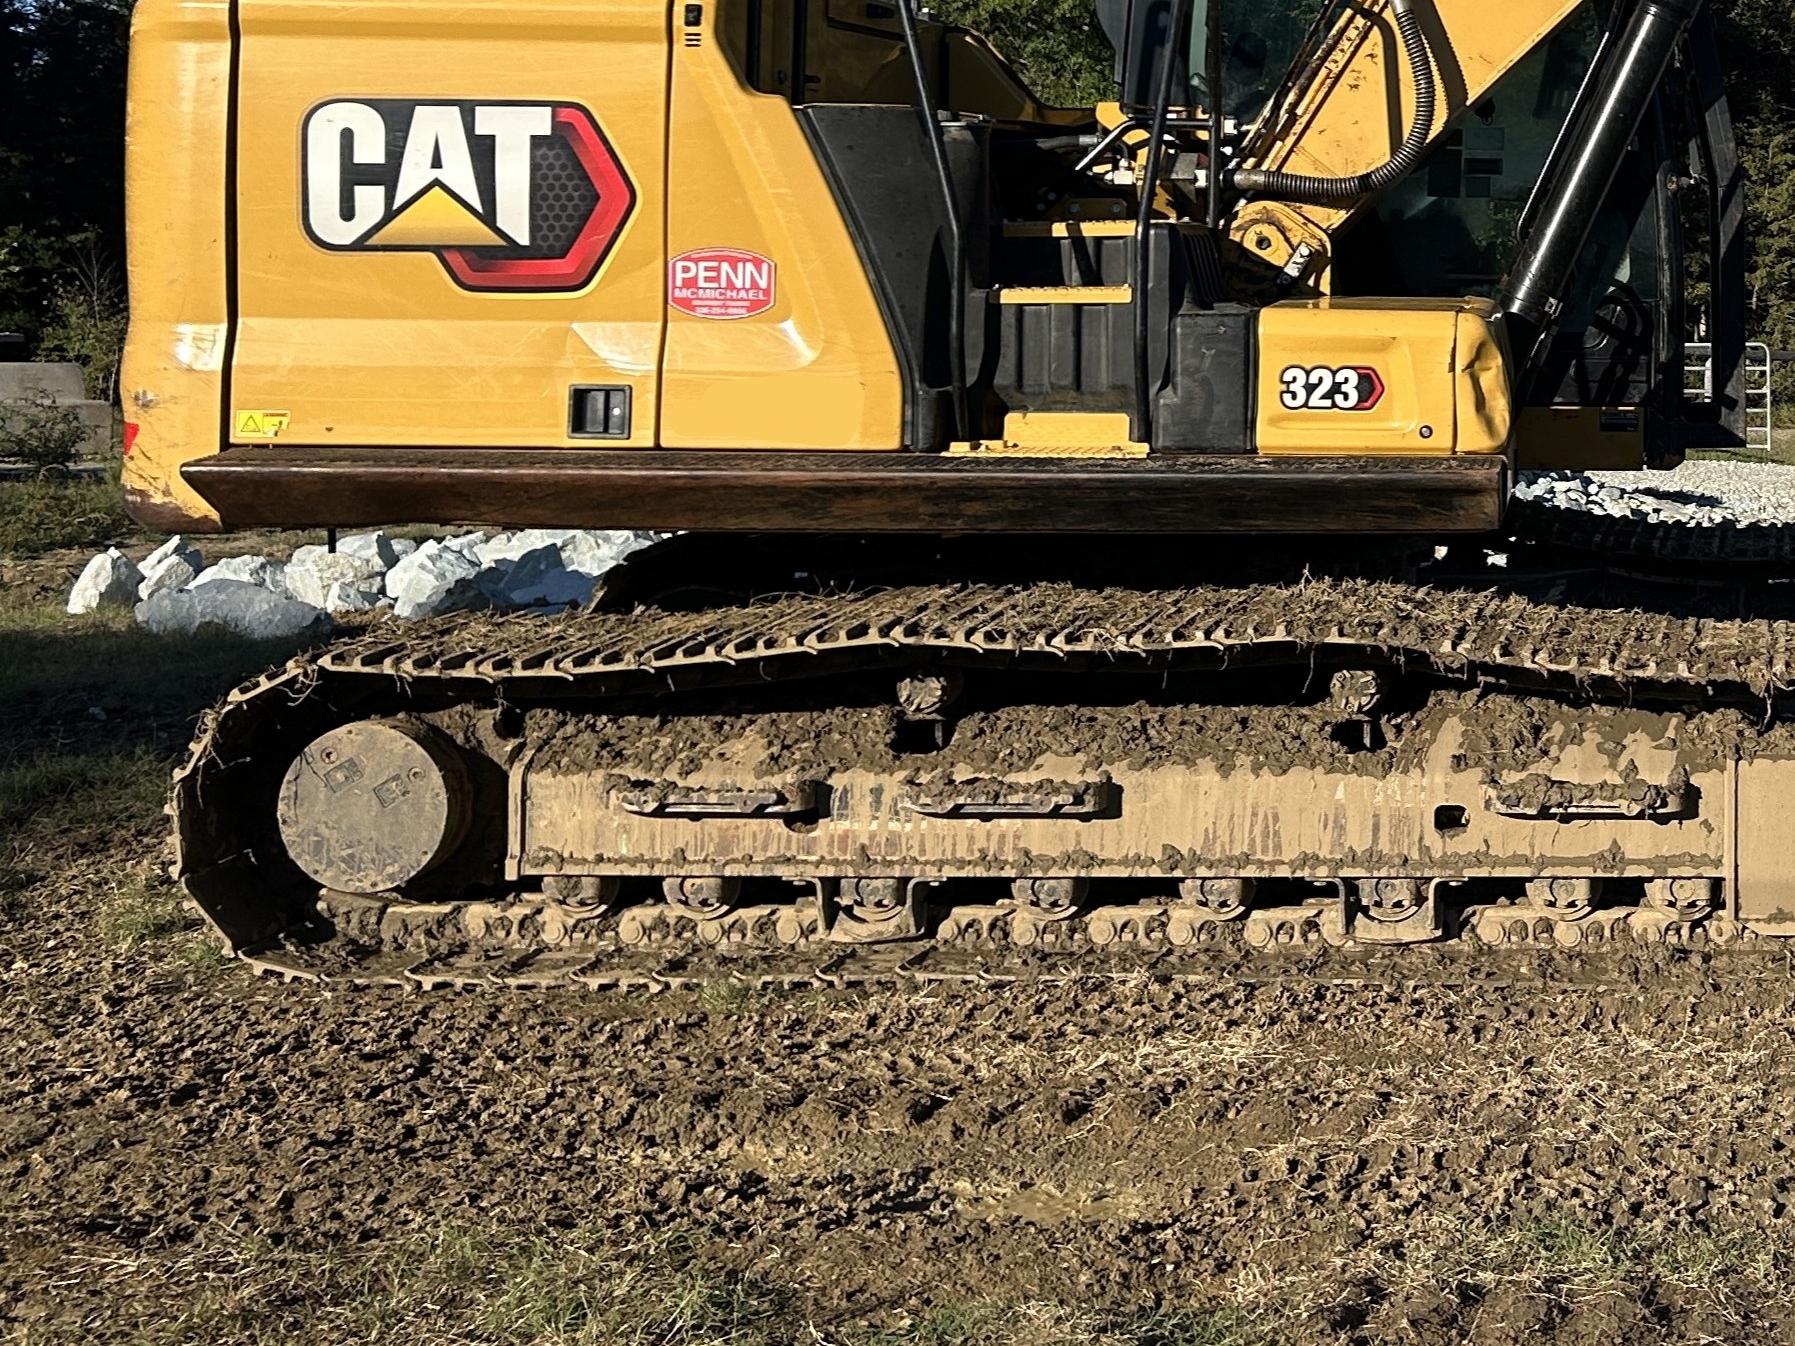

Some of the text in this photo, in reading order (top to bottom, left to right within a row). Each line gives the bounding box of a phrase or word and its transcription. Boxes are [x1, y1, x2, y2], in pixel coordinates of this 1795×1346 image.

[307, 102, 552, 246] CAT
[675, 260, 769, 289] PENN
[674, 287, 768, 300] MCMICHAEL
[1282, 367, 1359, 409] 323
